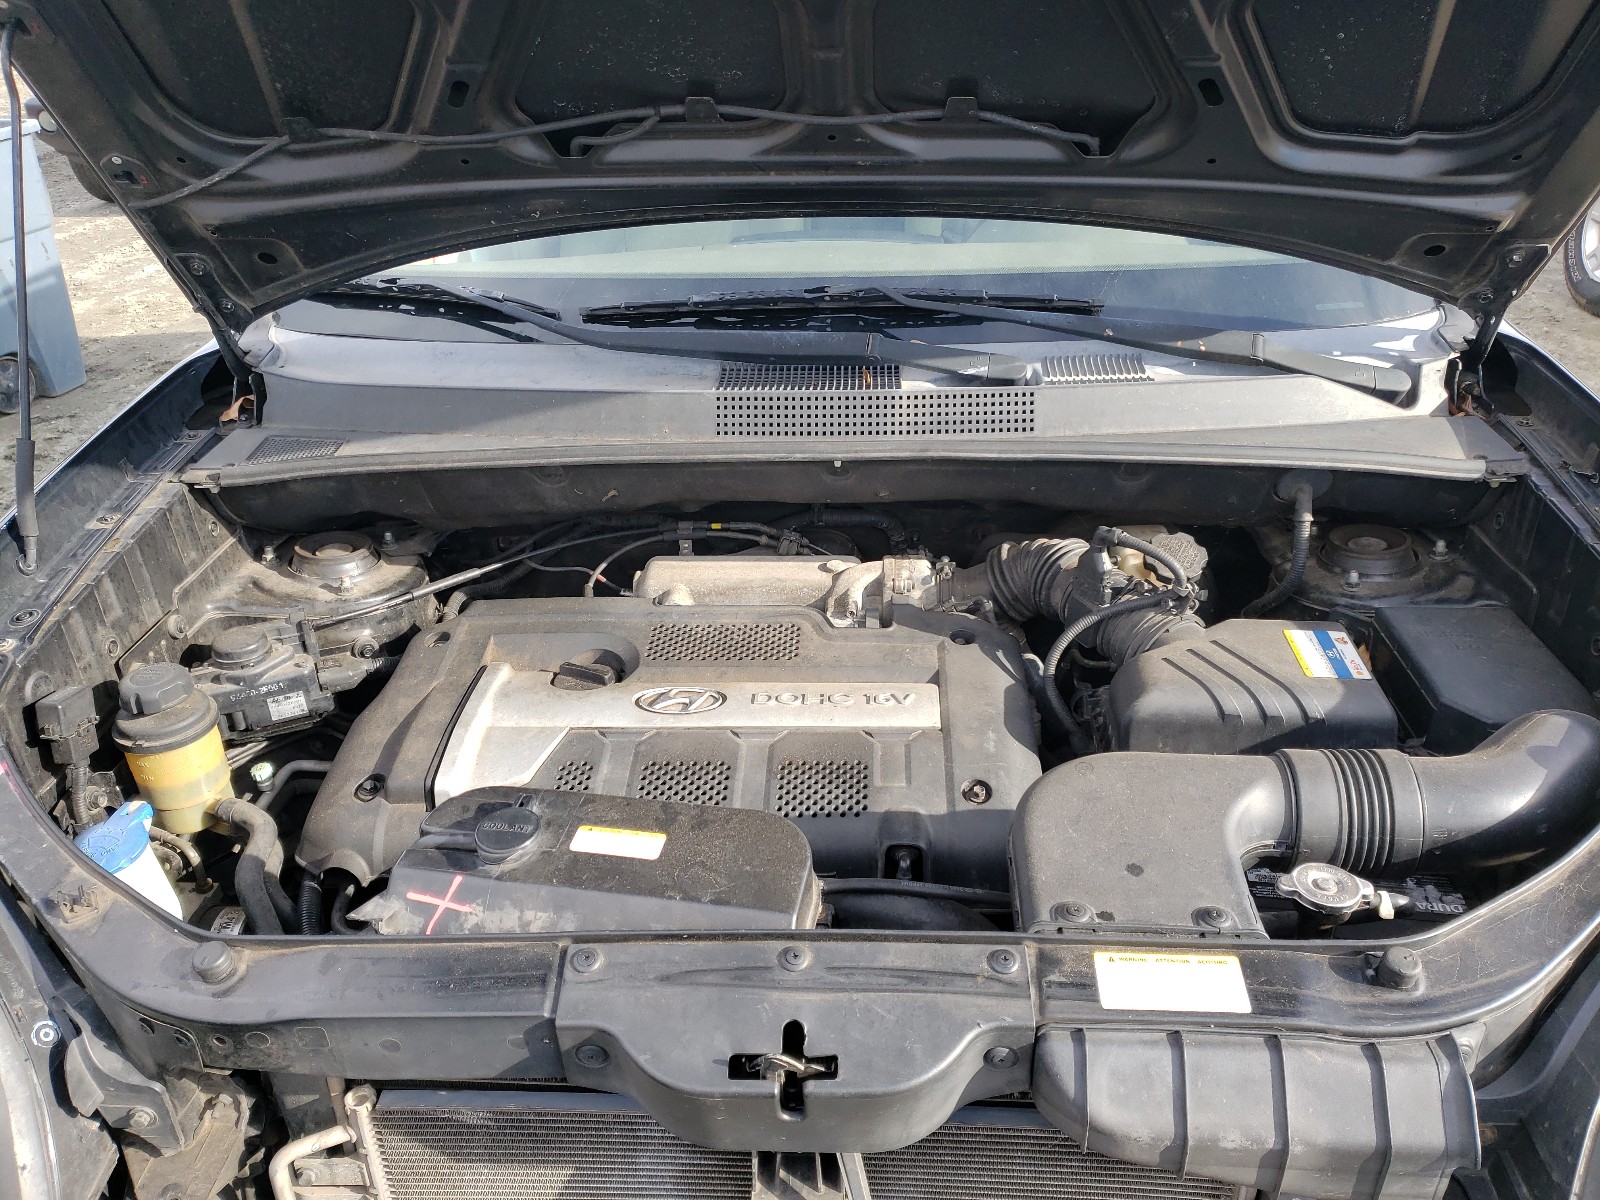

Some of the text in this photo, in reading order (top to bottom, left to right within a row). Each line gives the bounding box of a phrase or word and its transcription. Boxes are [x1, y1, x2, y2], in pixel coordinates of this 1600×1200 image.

[750, 691, 918, 706] DOHC 16V
[482, 820, 534, 834] COOLANT
[1414, 901, 1464, 913] DURA
